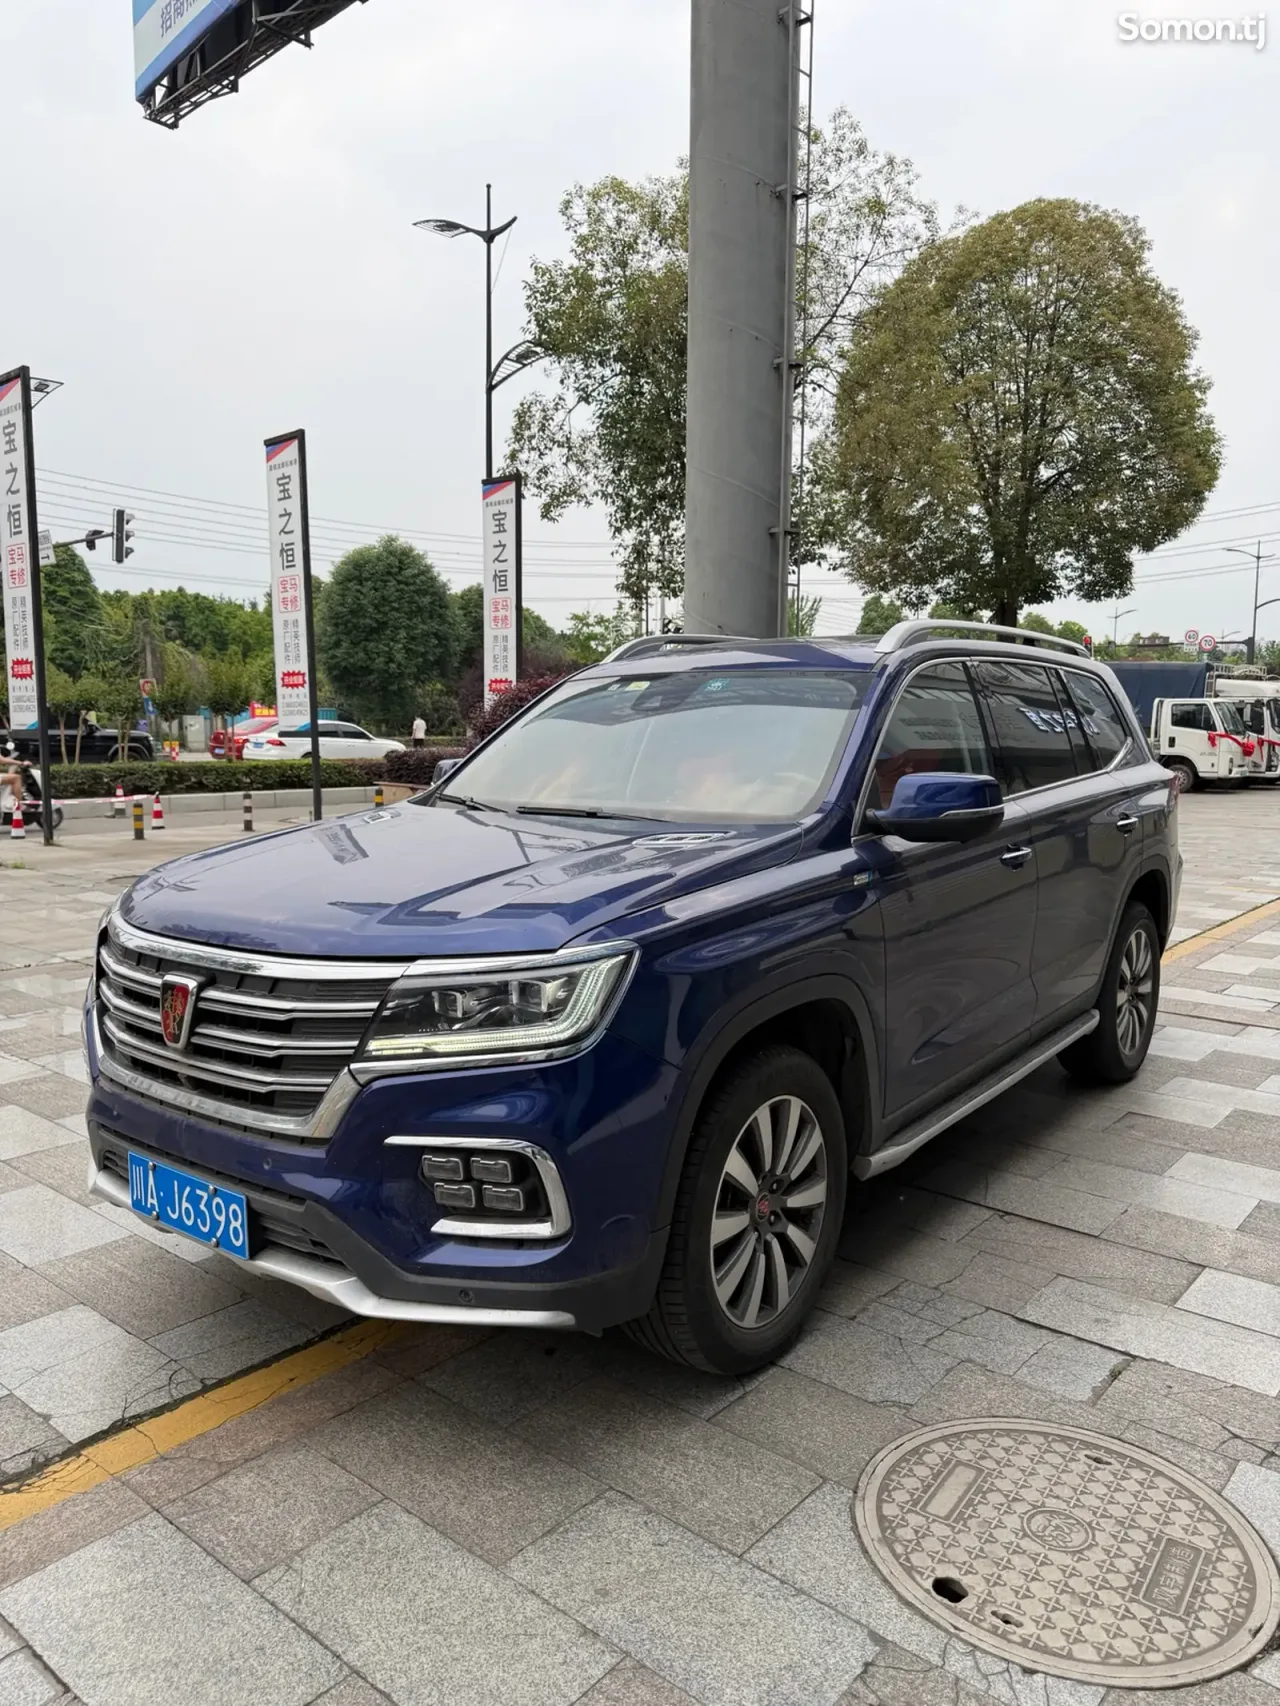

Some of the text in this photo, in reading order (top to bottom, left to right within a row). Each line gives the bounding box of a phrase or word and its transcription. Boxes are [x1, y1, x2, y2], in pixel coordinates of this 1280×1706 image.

[160, 0, 198, 37] 招商
[2, 419, 23, 539] 宝之恒
[276, 472, 297, 571] 宝之恒
[492, 509, 509, 594] 宝之恒
